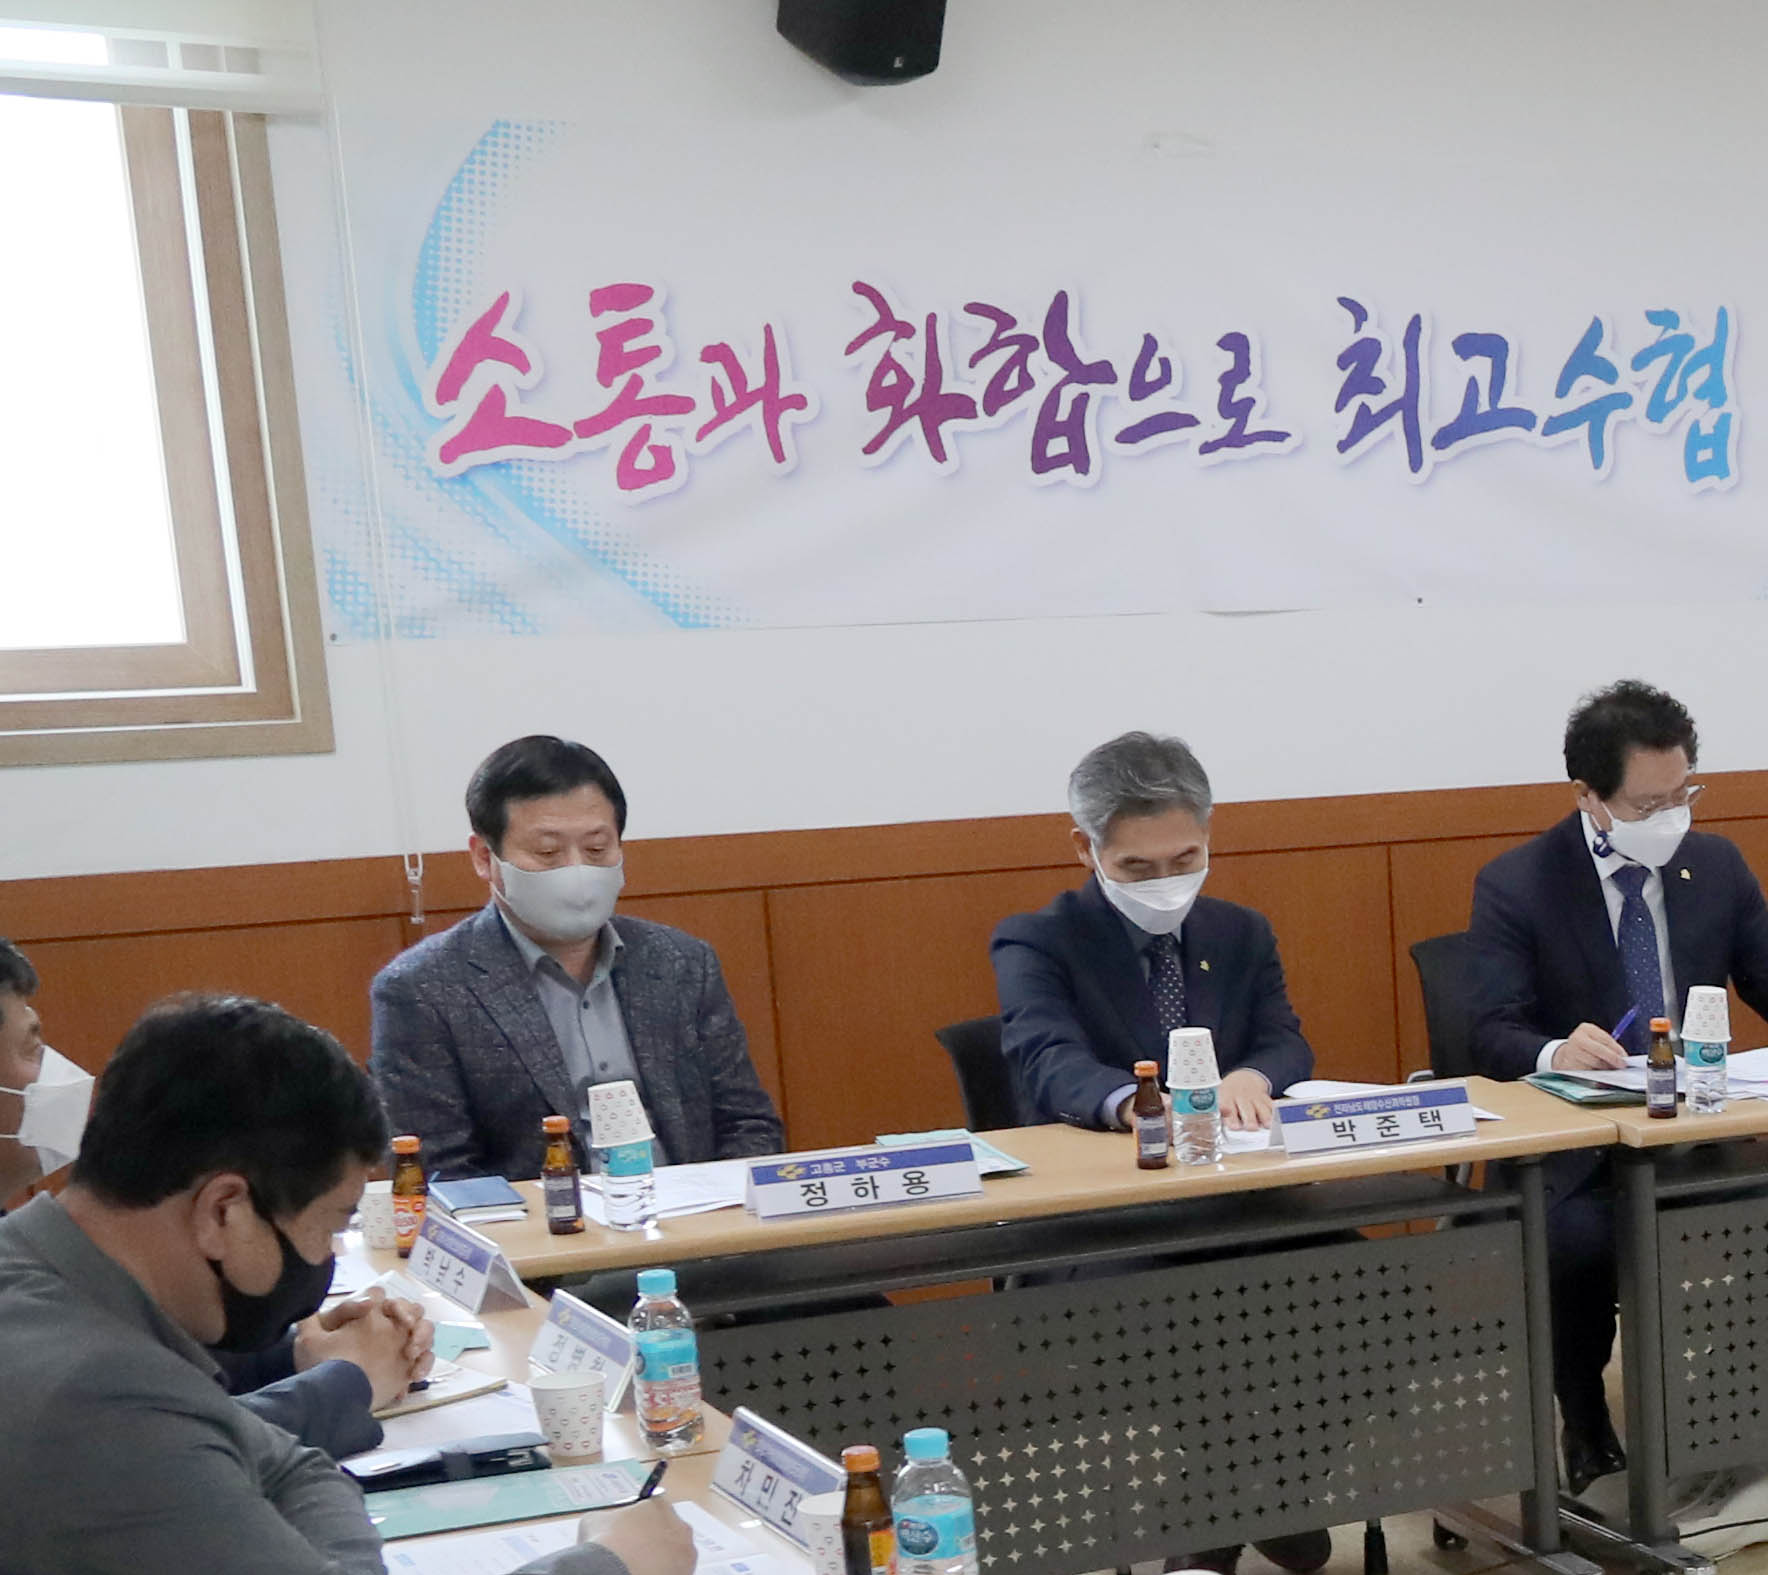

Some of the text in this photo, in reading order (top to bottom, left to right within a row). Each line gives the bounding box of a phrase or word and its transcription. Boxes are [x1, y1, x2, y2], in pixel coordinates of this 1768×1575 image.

[436, 280, 806, 492] 소통과
[848, 278, 1288, 475] 화합으로
[1335, 296, 1730, 484] 최고수협
[1331, 1109, 1445, 1143] 박준택
[800, 1170, 930, 1208] 정하용
